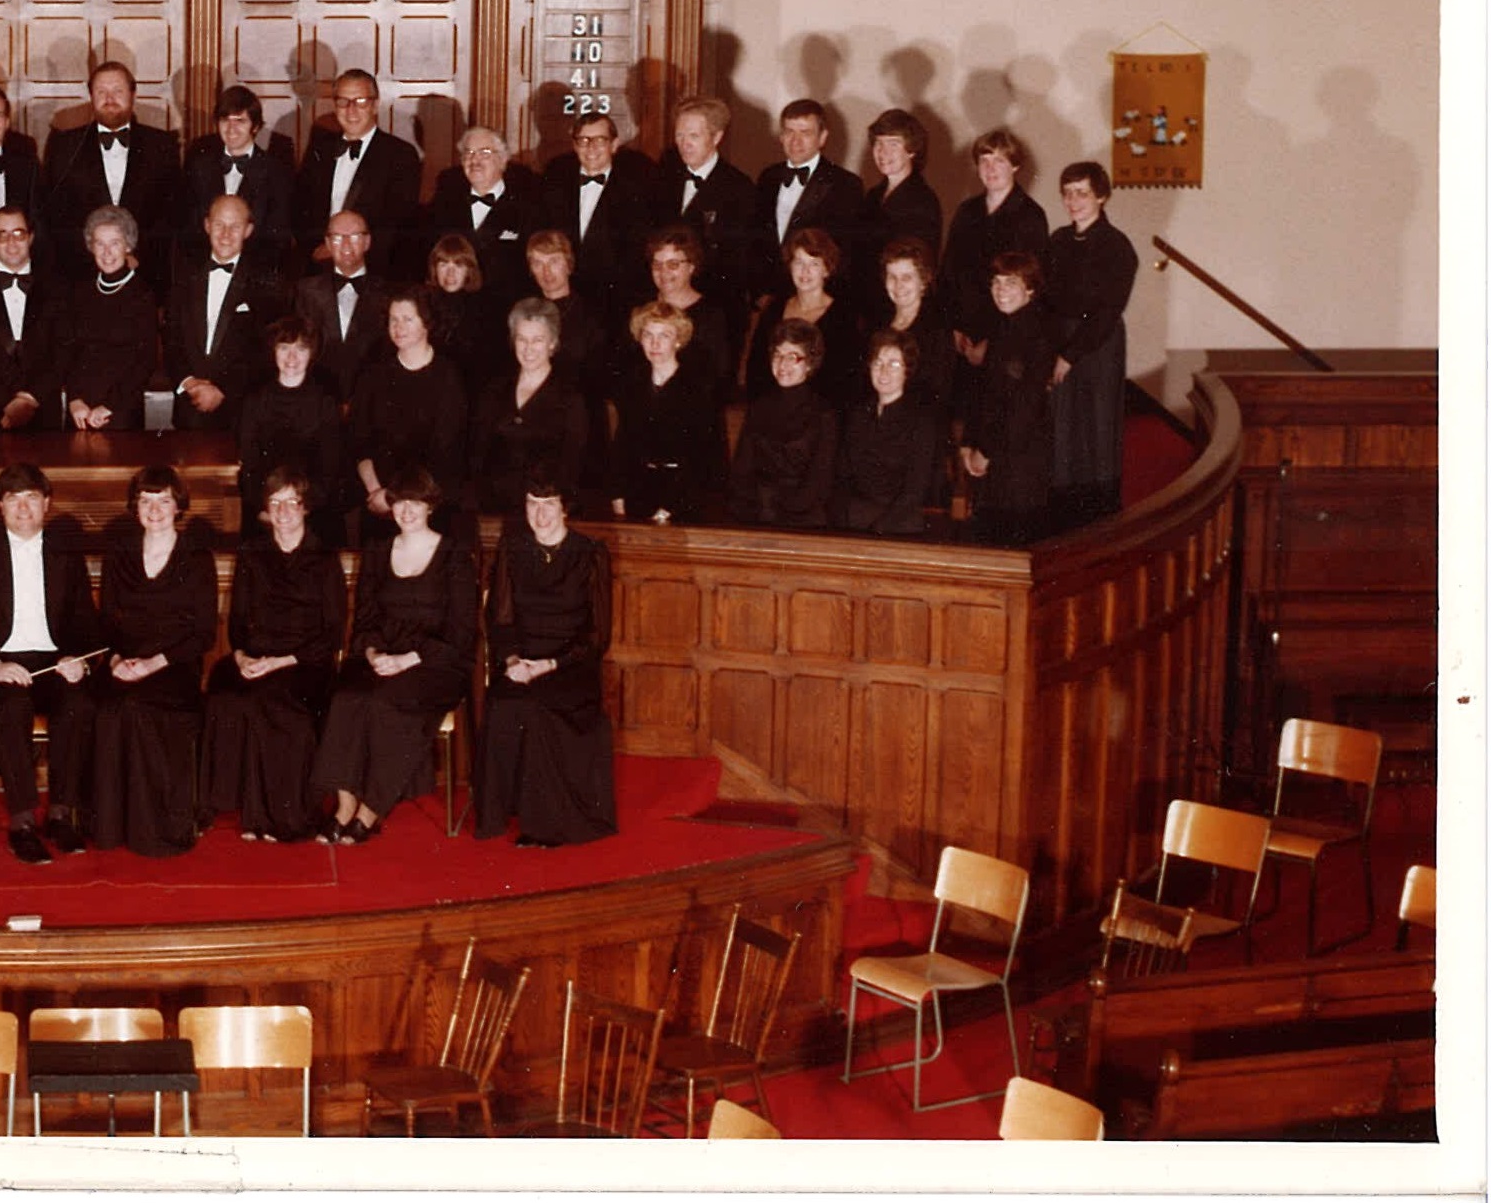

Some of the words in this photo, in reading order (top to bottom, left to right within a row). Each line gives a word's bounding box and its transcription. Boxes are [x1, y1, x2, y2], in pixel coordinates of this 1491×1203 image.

[573, 15, 599, 36] 31
[575, 42, 601, 62] 10
[570, 69, 597, 88] 41
[563, 95, 610, 114] 223
